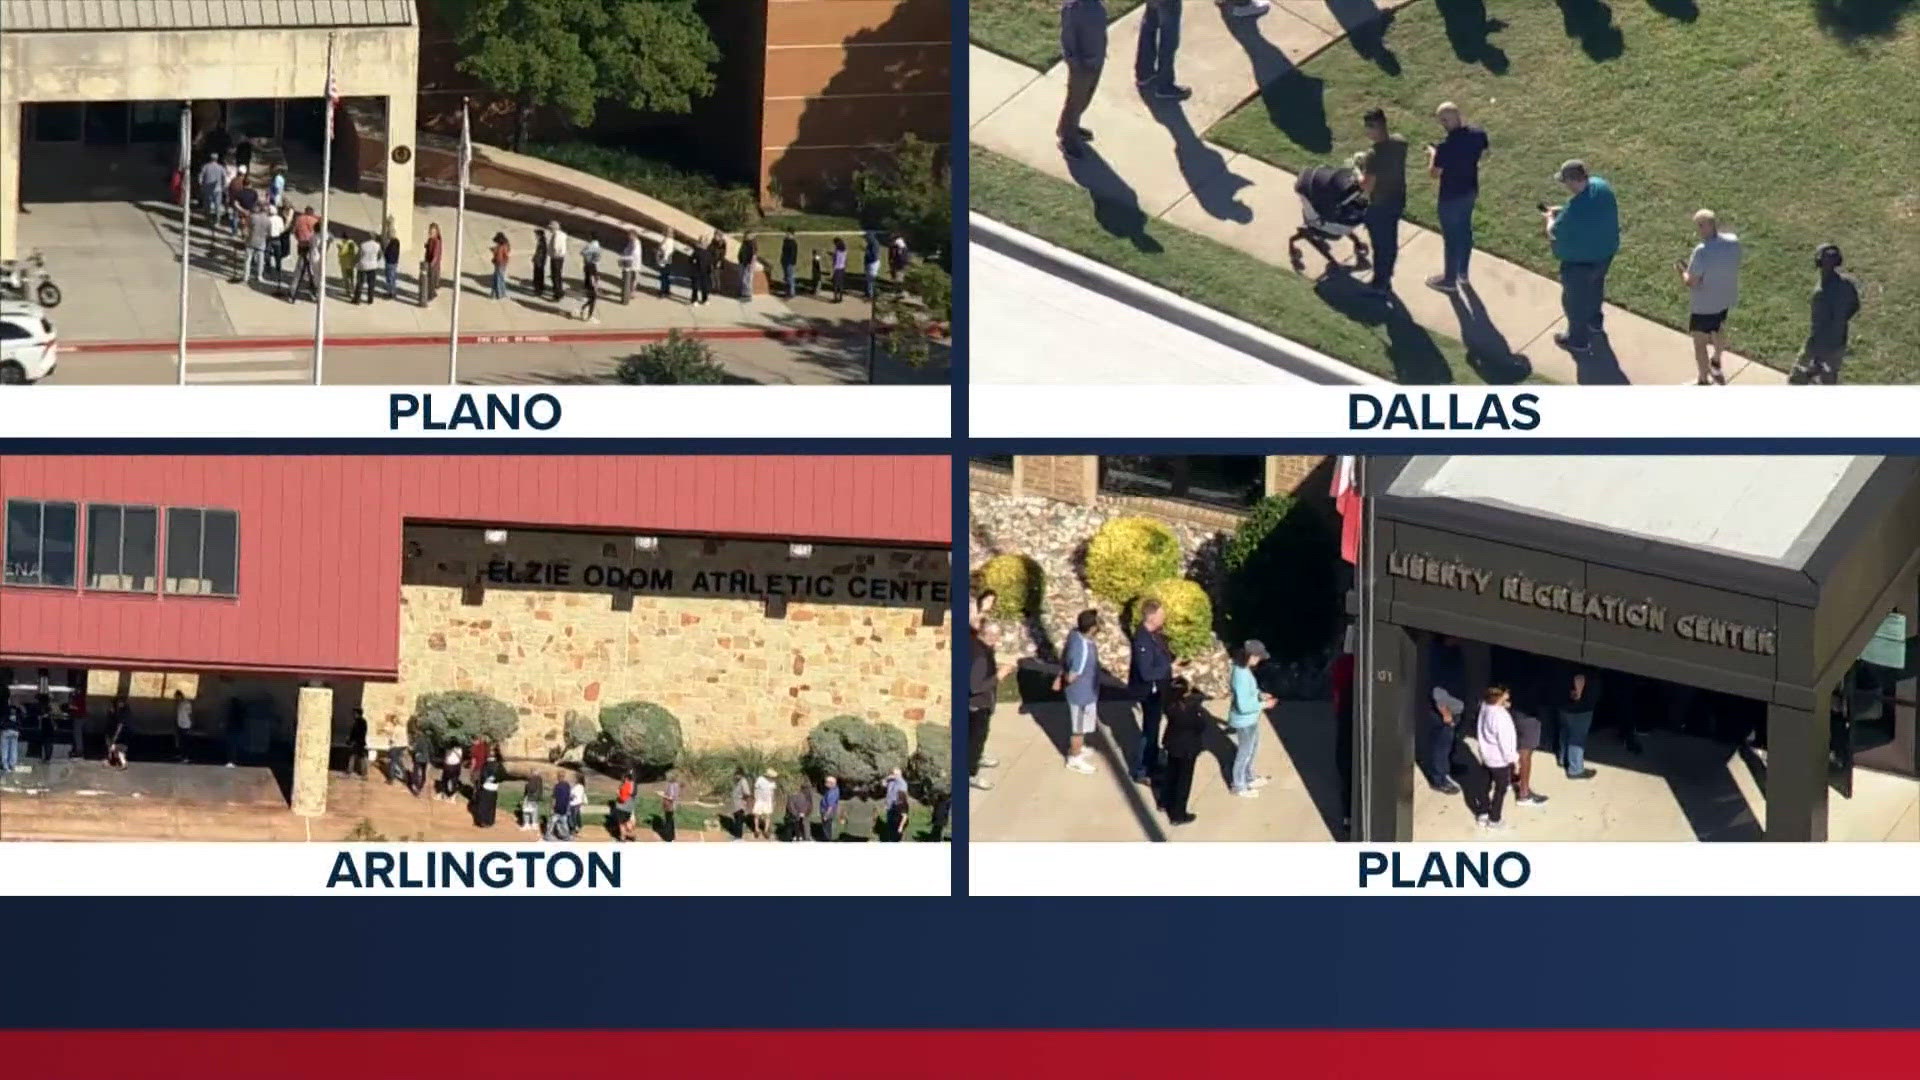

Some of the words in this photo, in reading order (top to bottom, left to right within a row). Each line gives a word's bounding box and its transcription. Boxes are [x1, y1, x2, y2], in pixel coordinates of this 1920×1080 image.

[487, 560, 571, 586] ELZIE
[584, 564, 674, 591] ODOM
[691, 569, 834, 597] ATHLETIC
[1388, 552, 1491, 594] LIBERTY
[1502, 573, 1666, 632] RECREATION
[1675, 614, 1777, 656] CENTER
